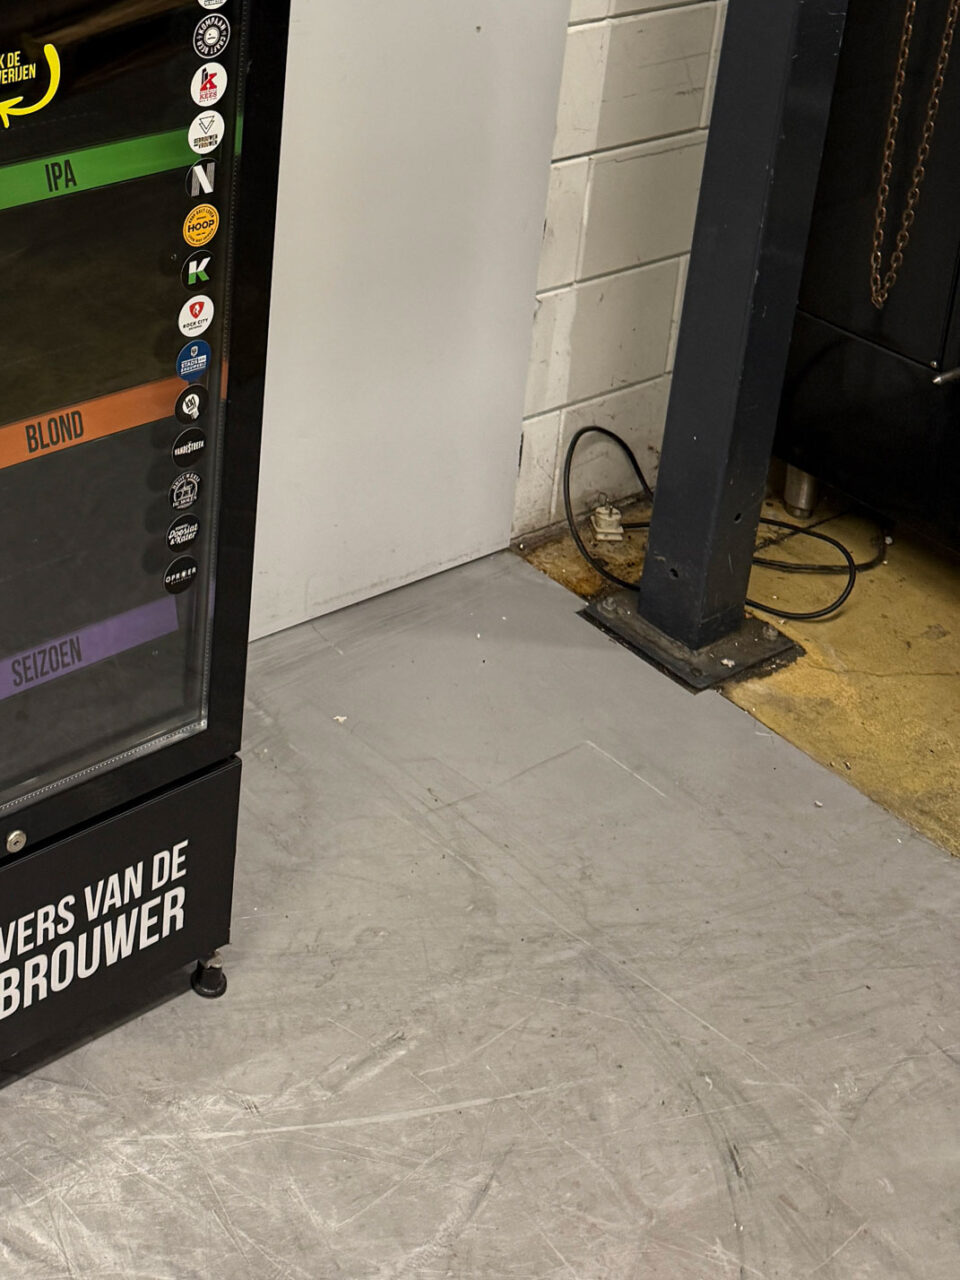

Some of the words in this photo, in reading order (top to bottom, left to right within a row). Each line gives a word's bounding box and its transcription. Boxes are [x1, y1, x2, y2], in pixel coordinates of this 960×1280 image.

[198, 16, 227, 34] KOMPAAN
[7, 51, 21, 66] DE
[45, 159, 77, 193] IPA
[191, 162, 215, 196] N
[187, 219, 215, 233] HOOP
[188, 257, 211, 285] K
[183, 321, 197, 329] ROCK
[25, 410, 84, 454] BLOND
[11, 635, 82, 687] SEIZOEN
[84, 861, 143, 922] VAN
[151, 839, 188, 891] DE
